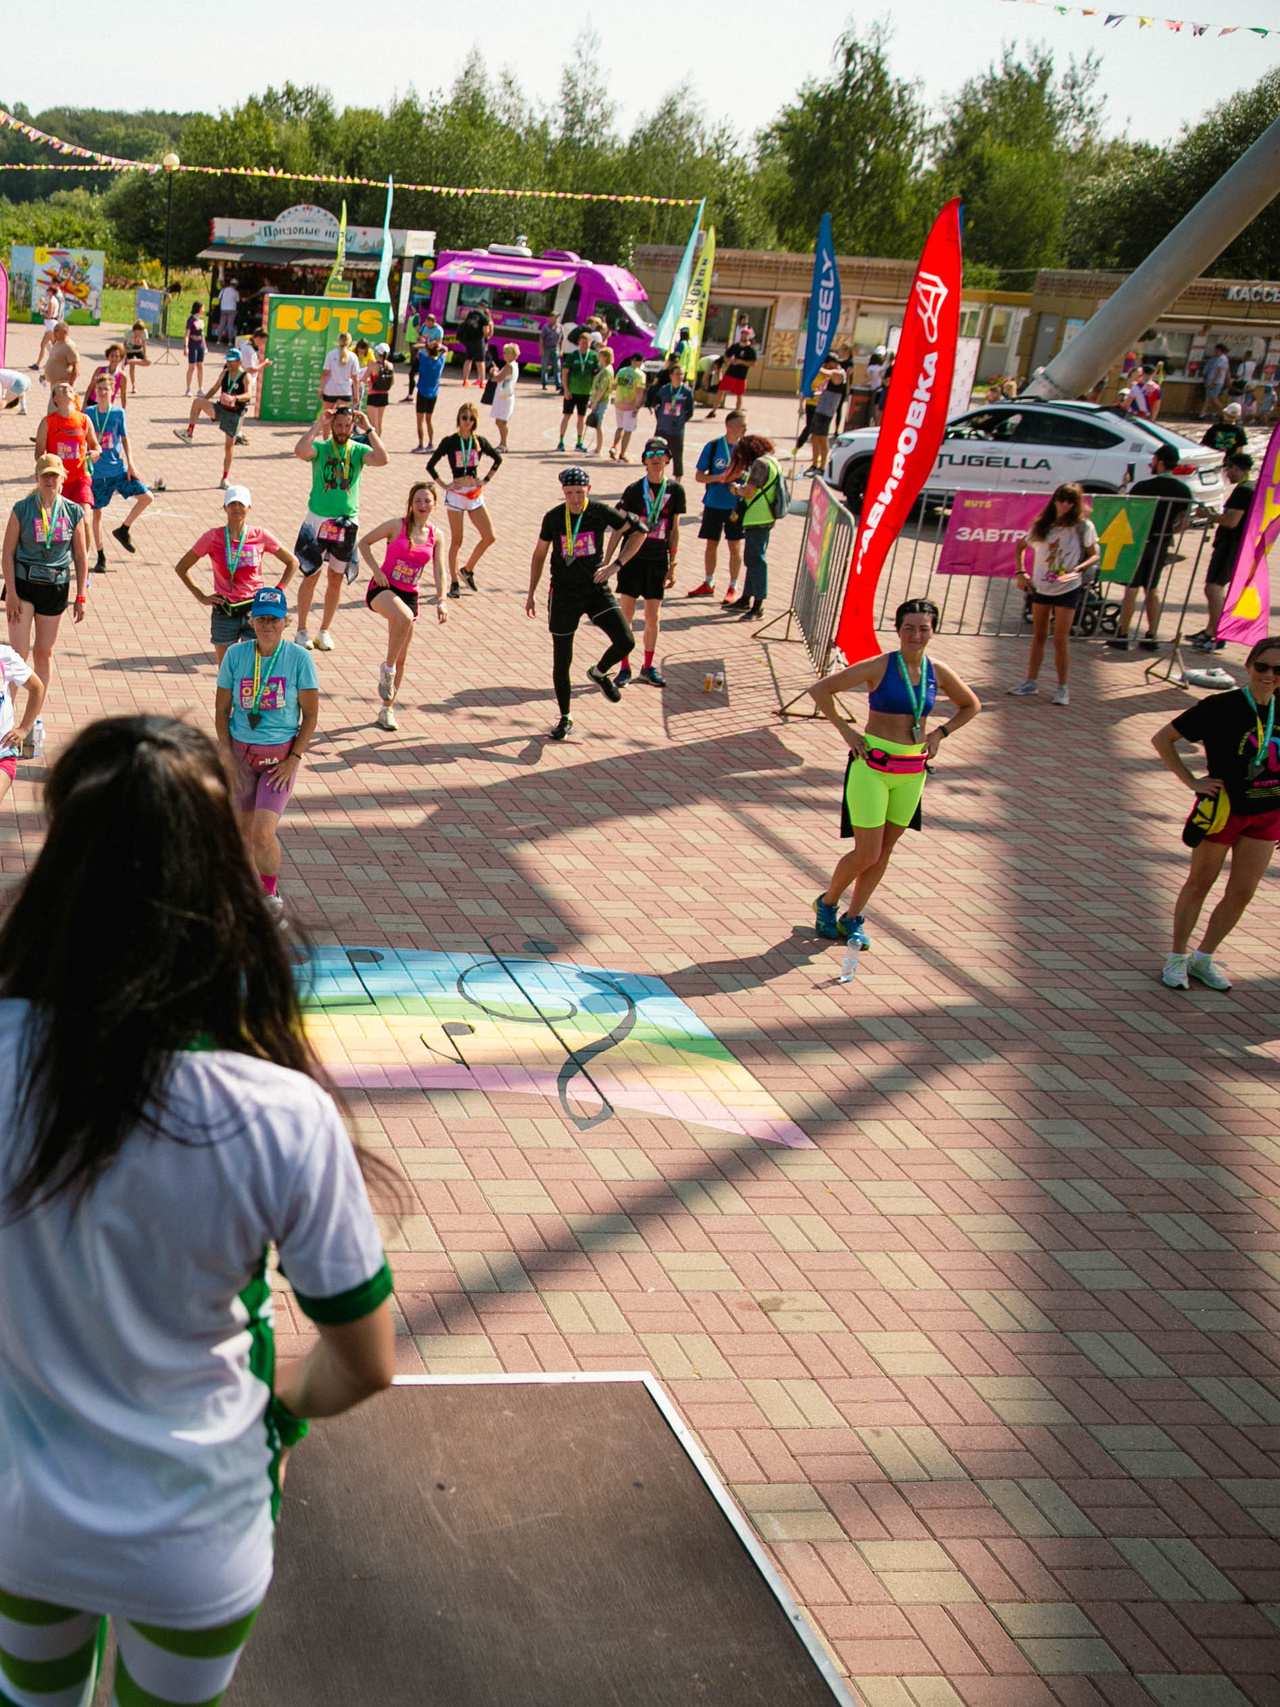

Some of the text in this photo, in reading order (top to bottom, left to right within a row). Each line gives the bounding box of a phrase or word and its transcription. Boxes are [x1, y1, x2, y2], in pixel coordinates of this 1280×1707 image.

[262, 225, 353, 243] Призовые игы
[815, 248, 835, 357] GEELY
[276, 304, 383, 335] RUTS
[857, 351, 939, 575] АВИРОВКА
[937, 453, 1052, 471] TUGELLA
[963, 499, 992, 509] RUTS
[955, 527, 1028, 543] ЗАВТР
